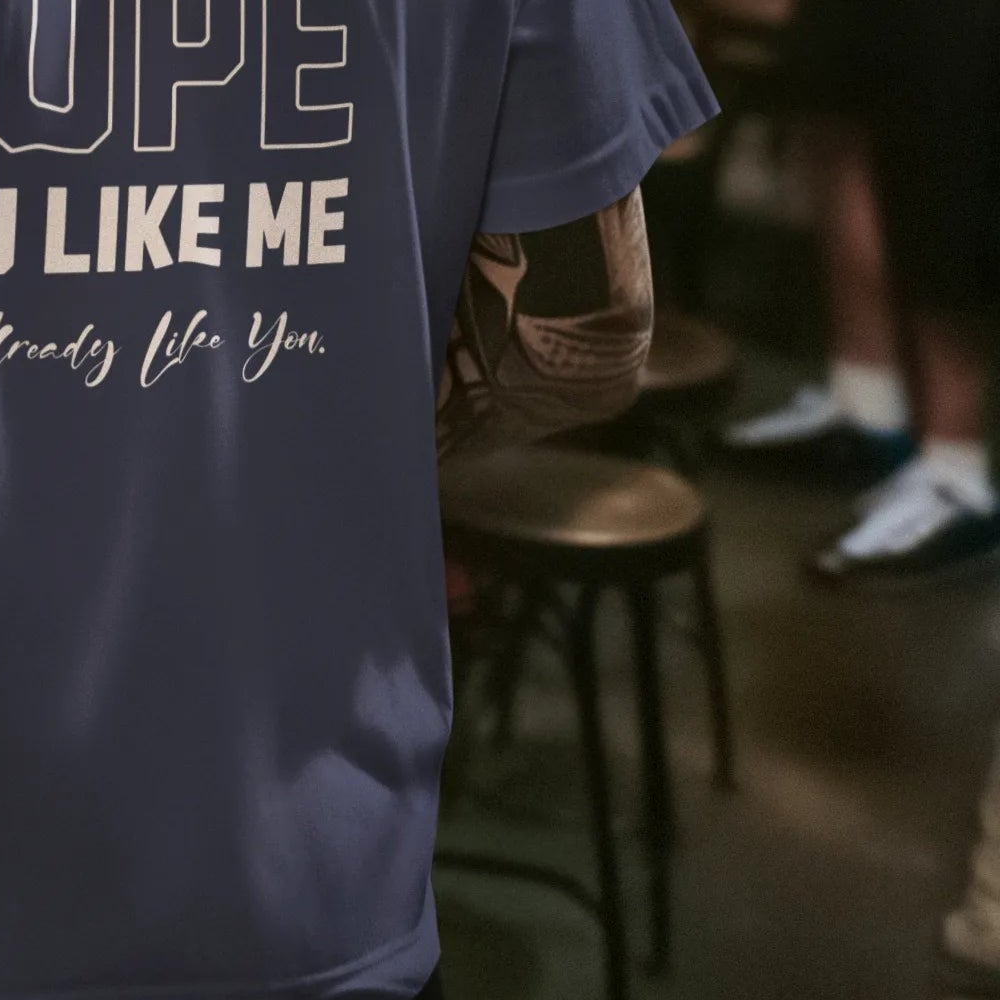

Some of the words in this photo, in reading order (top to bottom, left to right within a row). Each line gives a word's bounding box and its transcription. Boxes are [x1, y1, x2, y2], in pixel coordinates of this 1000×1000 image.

[43, 183, 225, 274] LIKE
[245, 177, 349, 268] ME
[139, 309, 225, 388] Like
[241, 311, 326, 383] You.
